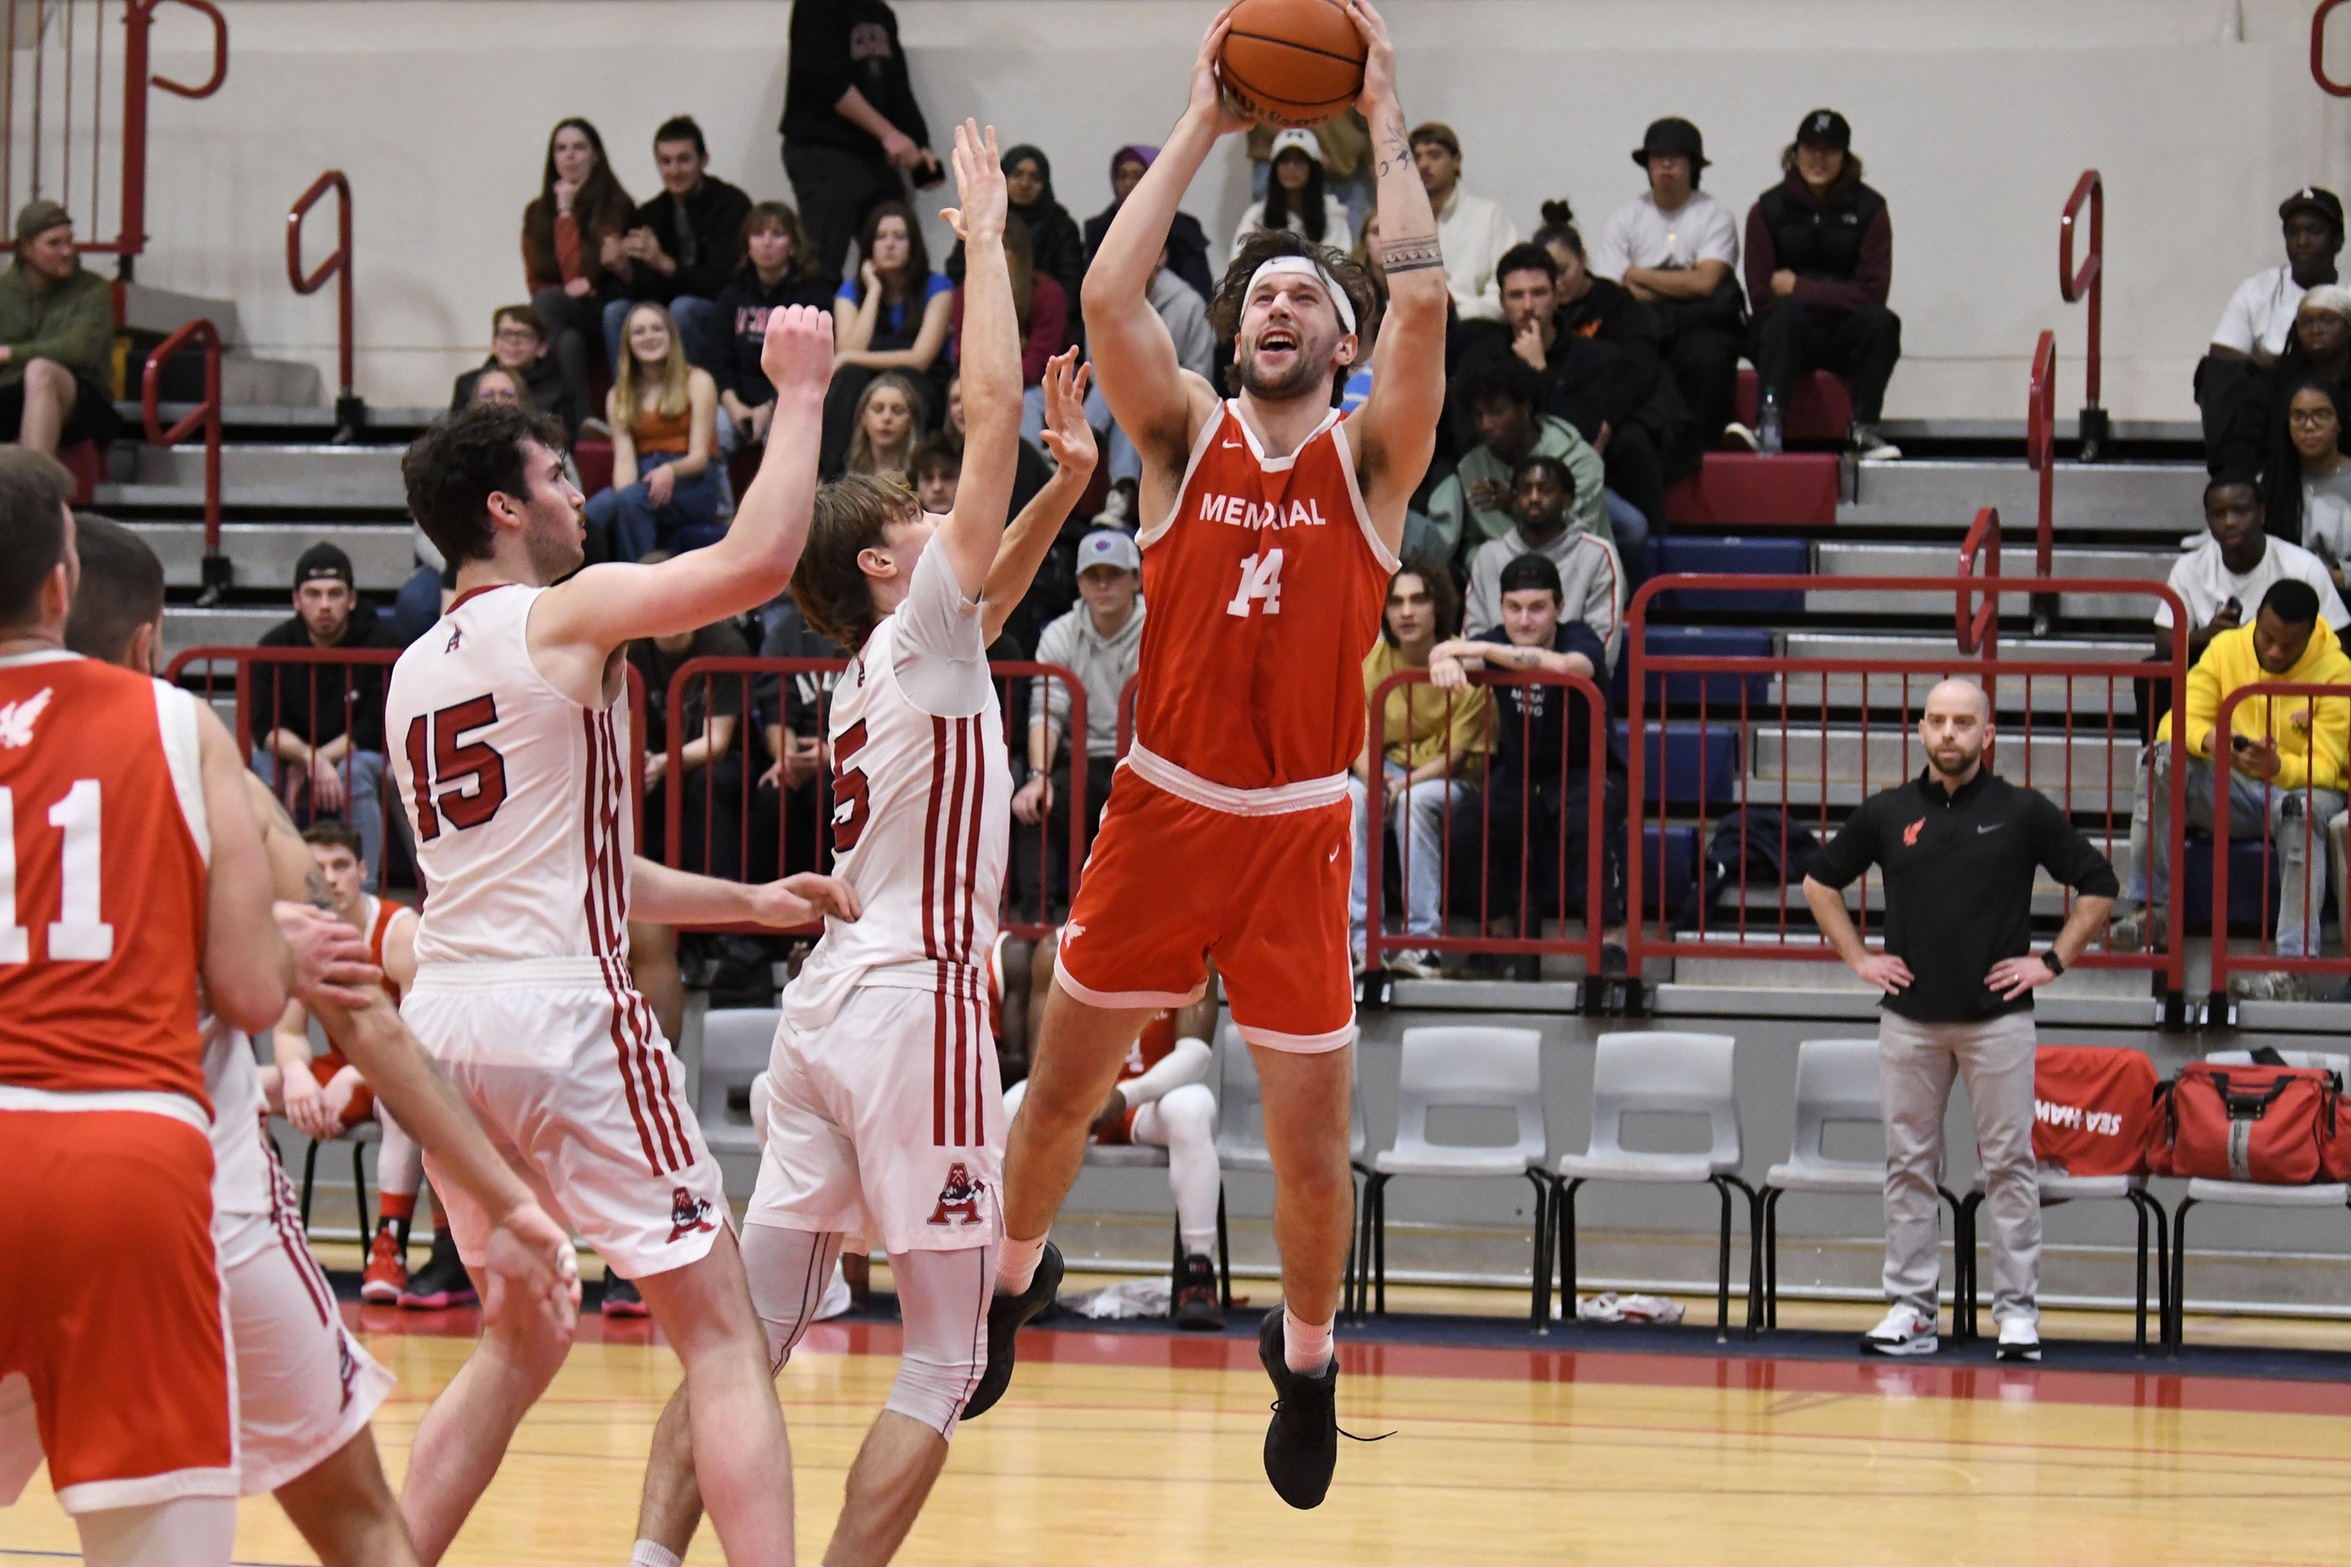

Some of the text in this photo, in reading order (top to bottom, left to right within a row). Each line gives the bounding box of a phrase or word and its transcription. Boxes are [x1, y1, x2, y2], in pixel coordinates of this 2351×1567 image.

[1199, 492, 1327, 531] MEMOIAL
[1226, 548, 1284, 618] 14
[405, 692, 508, 843] 15
